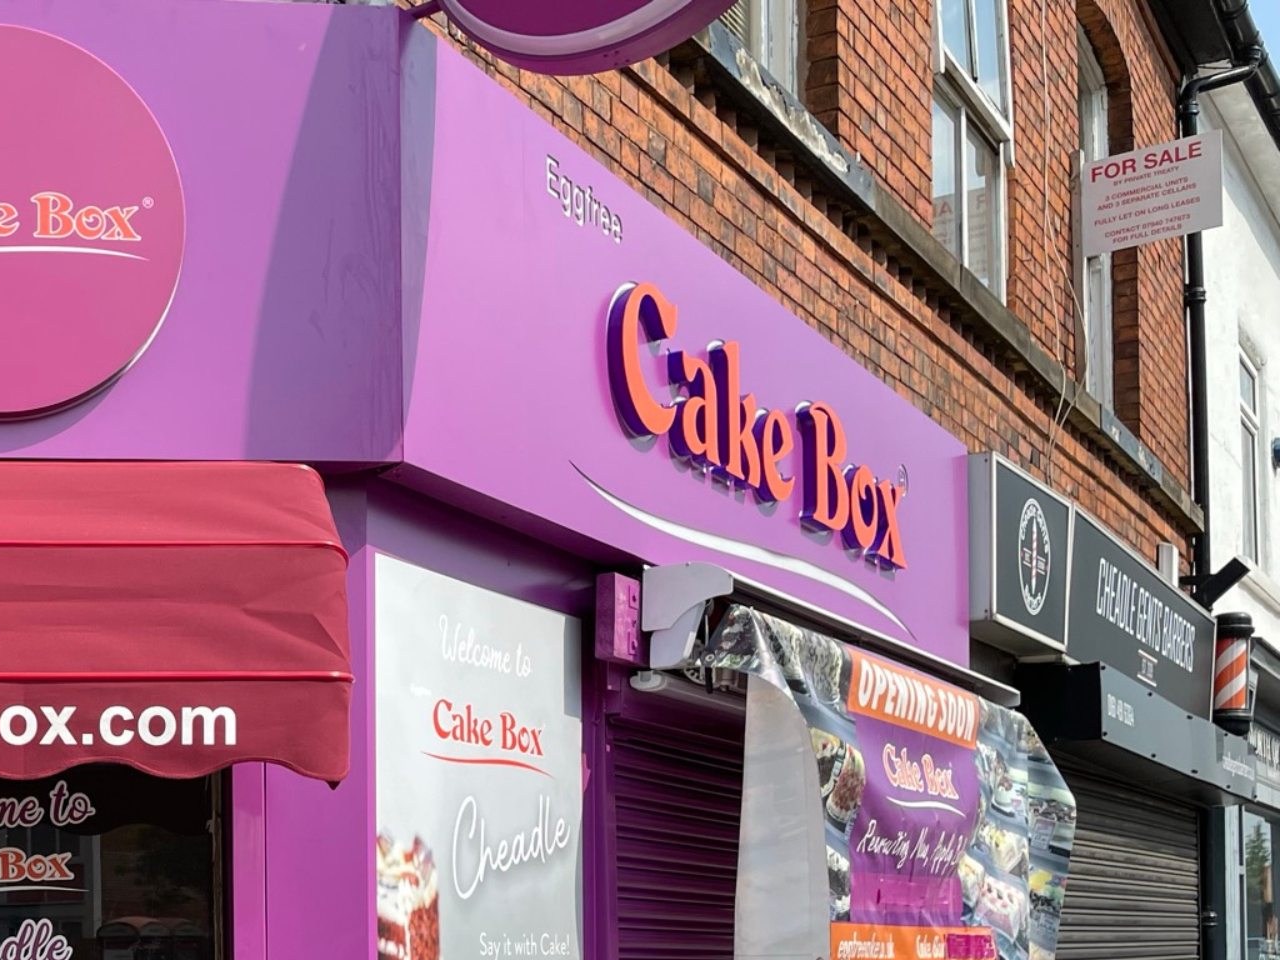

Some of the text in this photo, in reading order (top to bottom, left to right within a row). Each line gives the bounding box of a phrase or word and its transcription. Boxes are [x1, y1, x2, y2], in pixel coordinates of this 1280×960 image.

[1091, 141, 1202, 183] FOR SALE
[545, 154, 622, 243] Eggfree
[1094, 196, 1201, 227] FULLY LET ON LONG LEASES
[1098, 202, 1113, 211] AND
[1121, 191, 1160, 206] SEPARATE
[1161, 182, 1197, 196] CELLARS
[1111, 183, 1162, 200] COMMERCIAL
[1165, 176, 1188, 187] UNITS
[1105, 224, 1140, 238] CONTACT
[1112, 223, 1182, 244] FOR FULL DETAILS
[607, 281, 907, 571] Cake Box
[1096, 557, 1138, 636] CHEADLE
[1136, 587, 1163, 652] GENTS
[1161, 605, 1196, 673] BARBERS
[439, 613, 532, 677] Welcome to
[857, 658, 975, 741] OPENING SOON
[432, 698, 544, 756] Cake Box
[882, 743, 959, 800] Cake Box
[49, 780, 96, 829] to
[451, 794, 570, 899] Cheadle
[856, 819, 910, 869] Recruiting
[503, 934, 512, 955] it
[515, 933, 538, 955] with
[541, 933, 570, 956] Cake!
